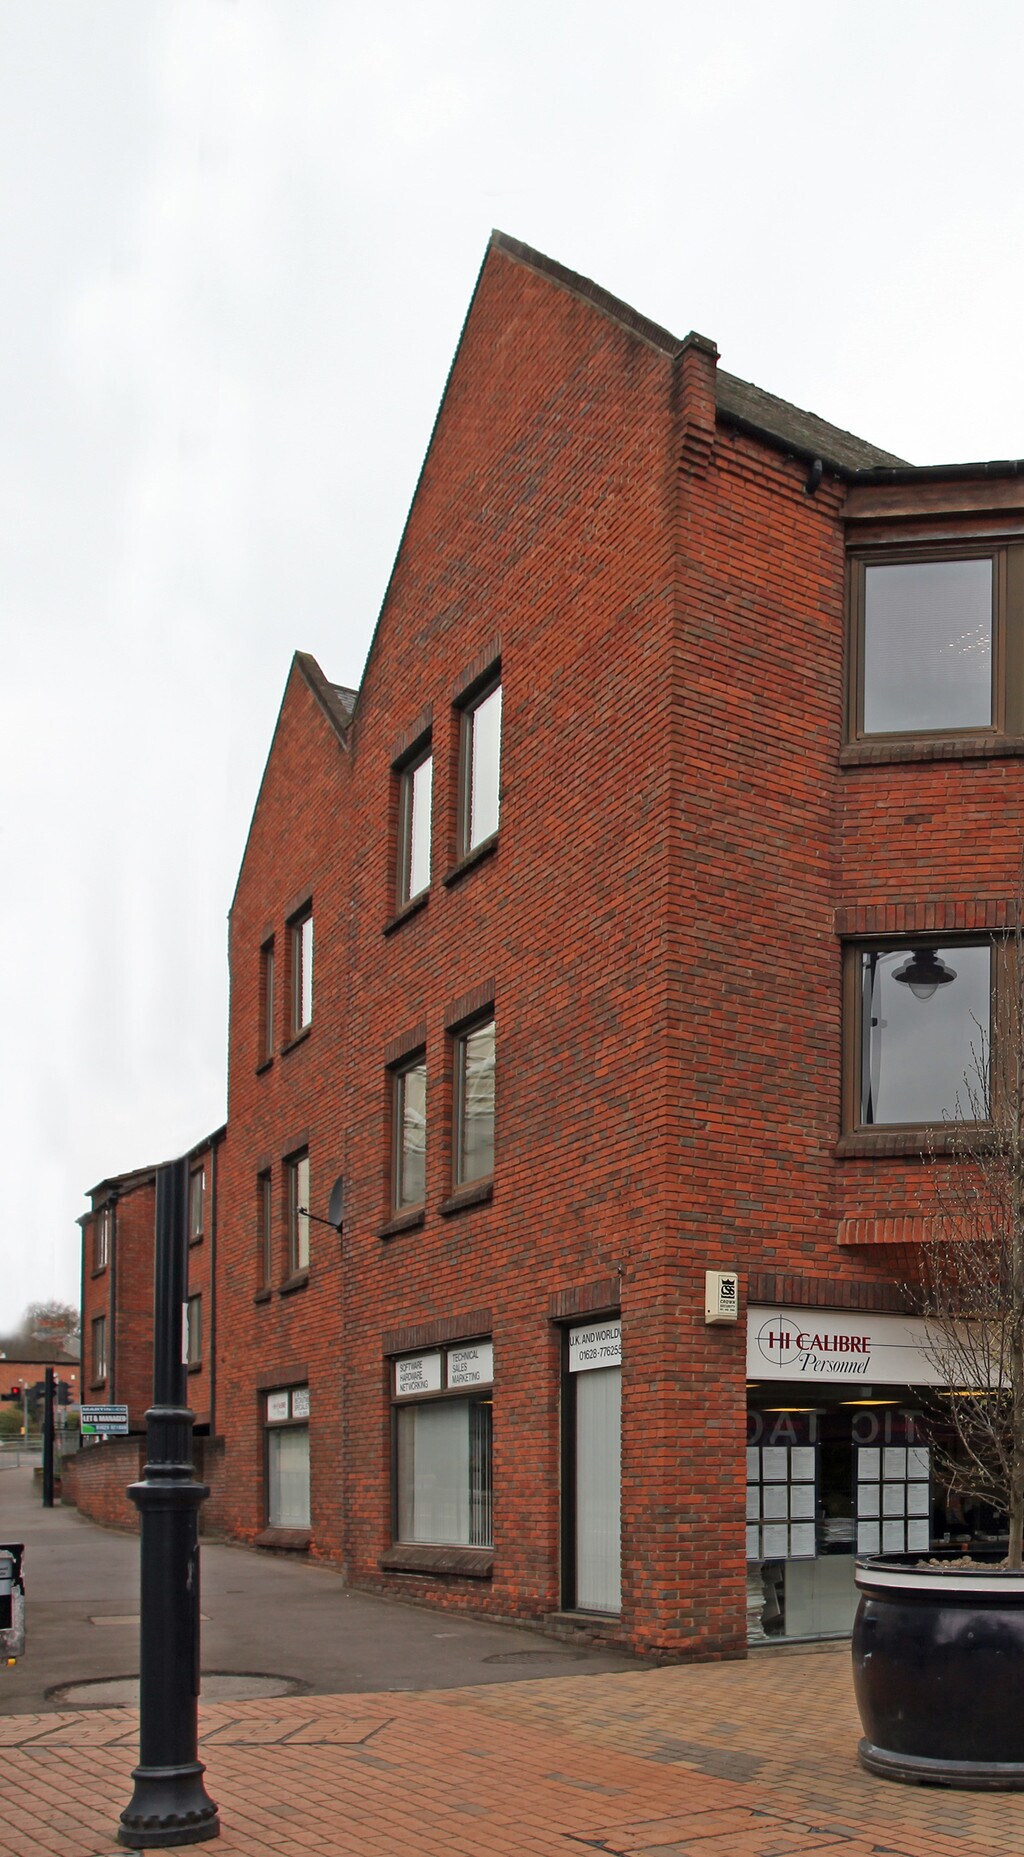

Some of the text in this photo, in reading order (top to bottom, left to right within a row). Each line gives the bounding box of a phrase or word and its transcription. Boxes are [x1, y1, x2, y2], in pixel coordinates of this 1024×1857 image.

[582, 1333, 595, 1344] AND
[595, 1327, 621, 1342] WORLD
[769, 1332, 870, 1353] HI CALIBRE
[452, 1350, 479, 1363] TECHNICAL
[400, 1360, 423, 1373] SOFTWARE
[452, 1362, 468, 1373] SALES
[799, 1353, 870, 1374] Personnel
[400, 1370, 423, 1383] HARDWARE
[452, 1371, 480, 1384] MARKETING
[400, 1380, 428, 1392] NETWORKING
